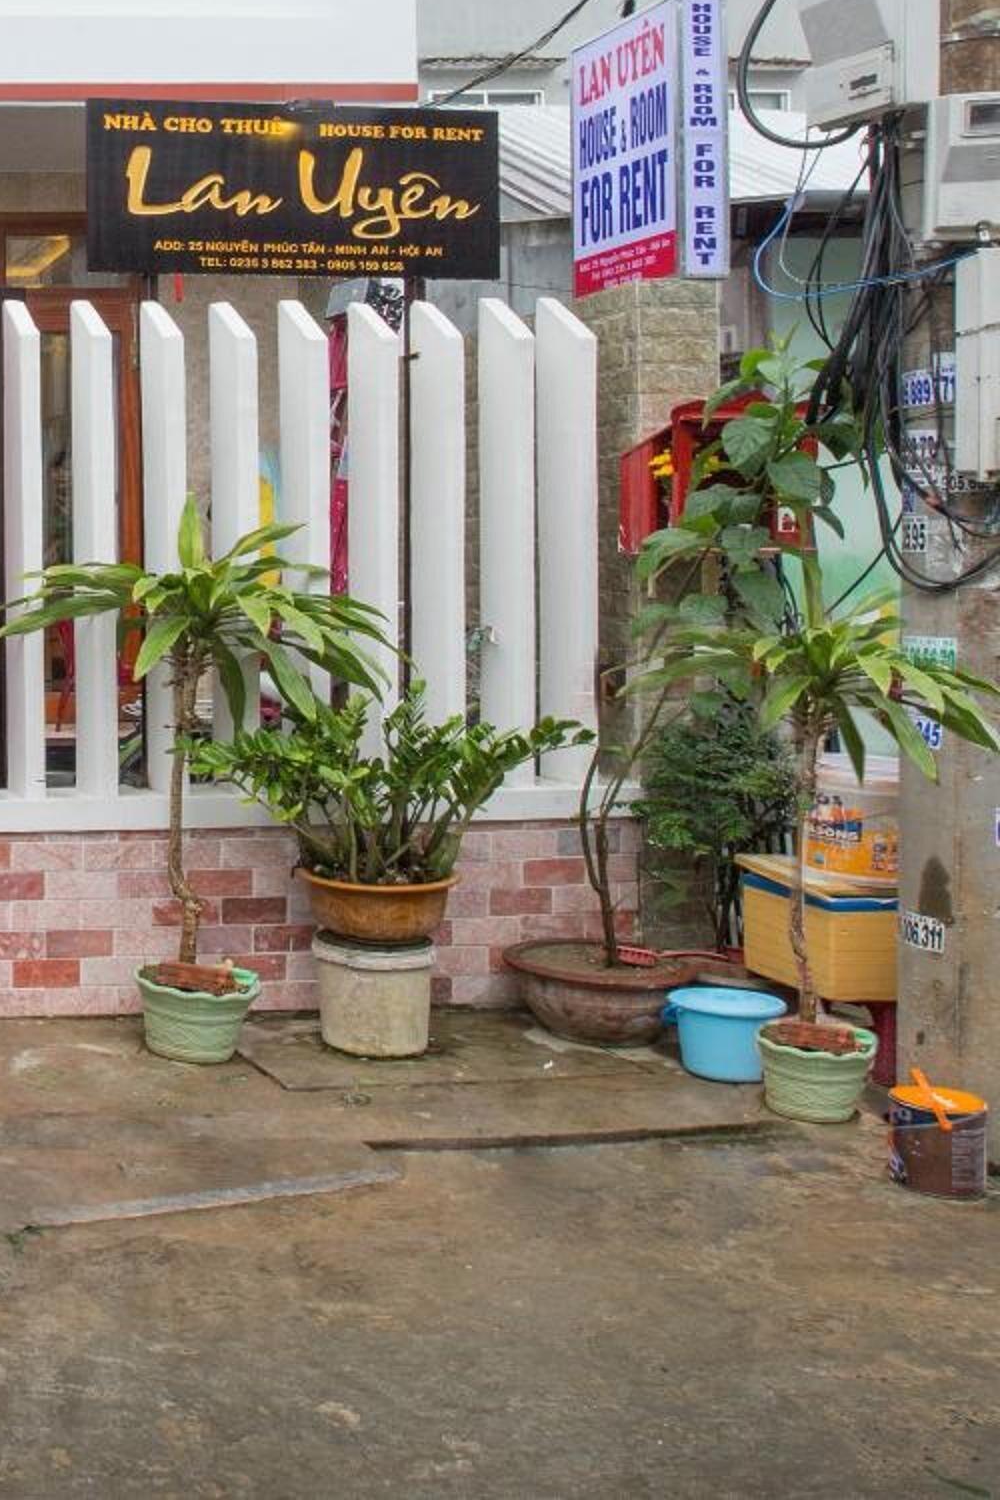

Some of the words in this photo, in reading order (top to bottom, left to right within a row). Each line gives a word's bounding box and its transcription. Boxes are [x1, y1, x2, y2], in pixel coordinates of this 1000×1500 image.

[691, 3, 712, 57] HOUSE
[579, 52, 613, 106] LAN
[103, 112, 157, 132] NHÀ
[163, 116, 213, 133] CHO
[579, 106, 617, 170] HOUSE
[629, 82, 668, 149] ROOM
[689, 83, 717, 127] ROOM
[319, 123, 386, 139] HOUSE
[389, 125, 428, 140] FOR
[432, 126, 485, 142] RENT
[693, 143, 715, 188] FOR
[126, 145, 285, 217] Lan
[298, 147, 481, 239] Uyên
[580, 171, 614, 247] FOR
[619, 148, 669, 235] RENT
[153, 240, 185, 252] ADD:
[335, 244, 368, 256] MINH
[371, 244, 390, 256] AN
[425, 245, 443, 258] AN
[693, 205, 717, 266] RENT
[200, 256, 228, 268] TEL:
